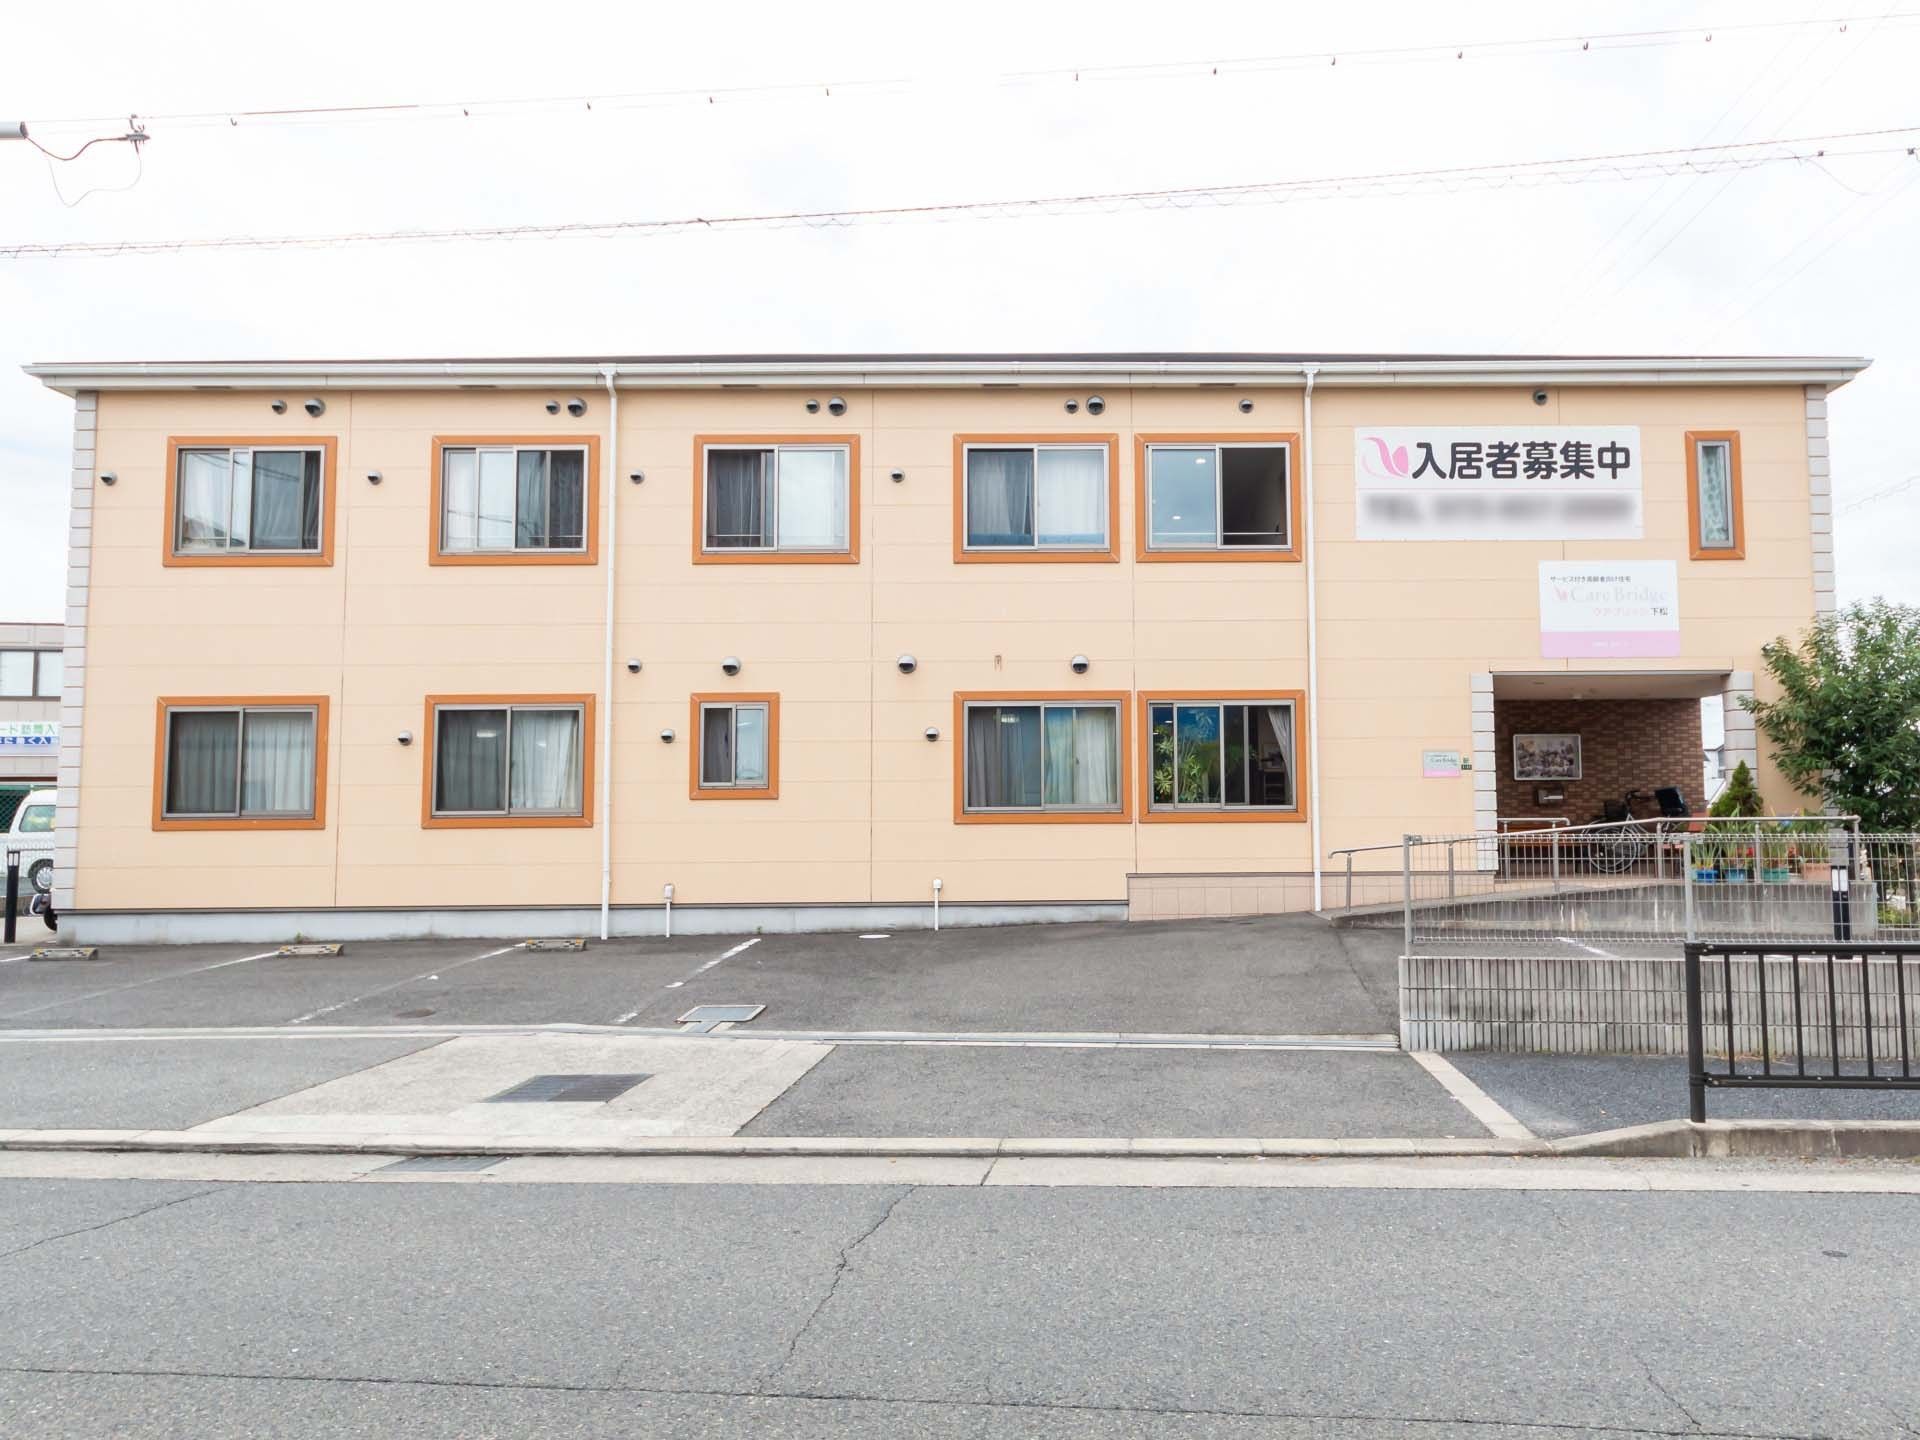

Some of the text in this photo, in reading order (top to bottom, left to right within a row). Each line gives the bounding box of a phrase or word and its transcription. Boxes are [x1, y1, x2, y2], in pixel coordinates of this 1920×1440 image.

[1411, 440, 1631, 480] 入居者募集中
[1569, 585, 1668, 605] Care Bridge
